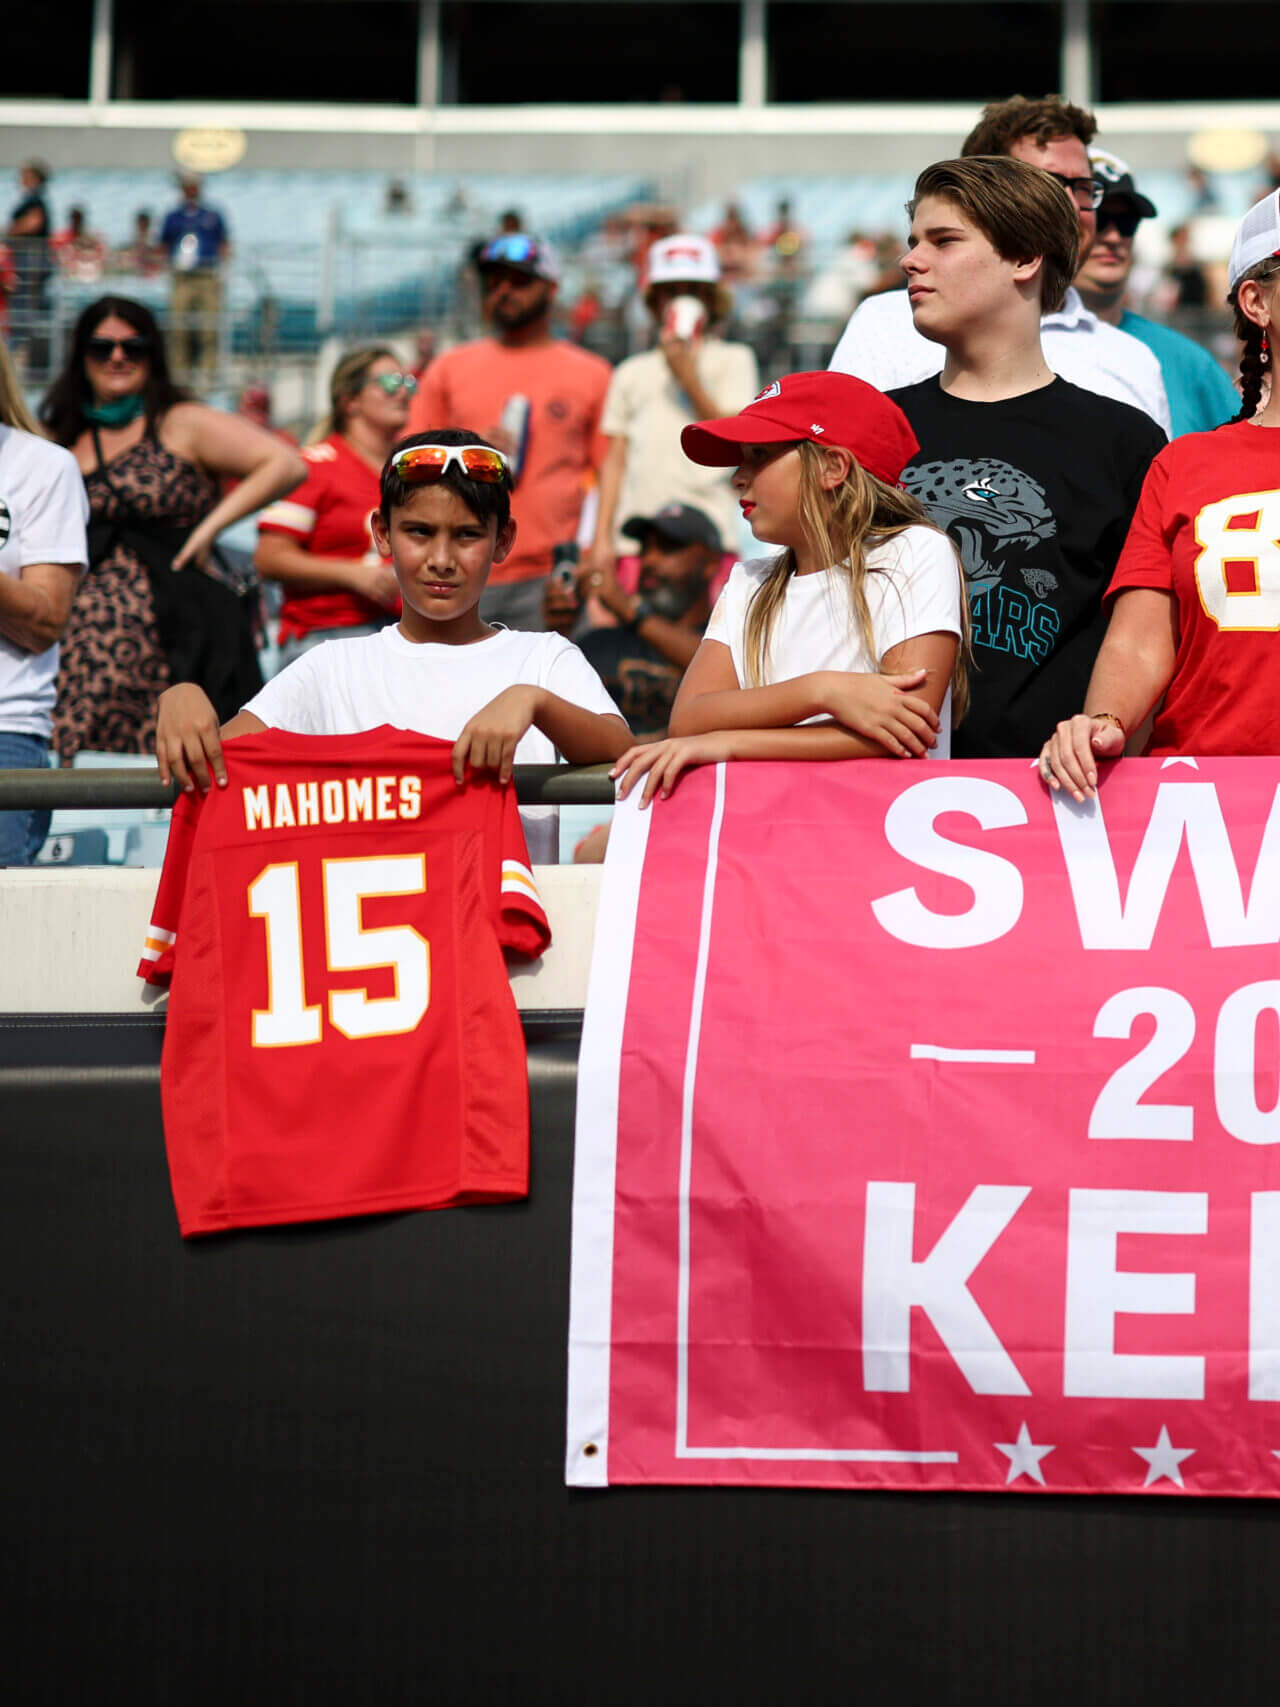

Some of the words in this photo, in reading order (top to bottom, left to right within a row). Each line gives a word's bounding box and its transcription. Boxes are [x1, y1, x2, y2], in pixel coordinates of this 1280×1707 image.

[969, 582, 1061, 666] ARS
[243, 775, 422, 830] MAHOMES
[247, 853, 430, 1048] 15
